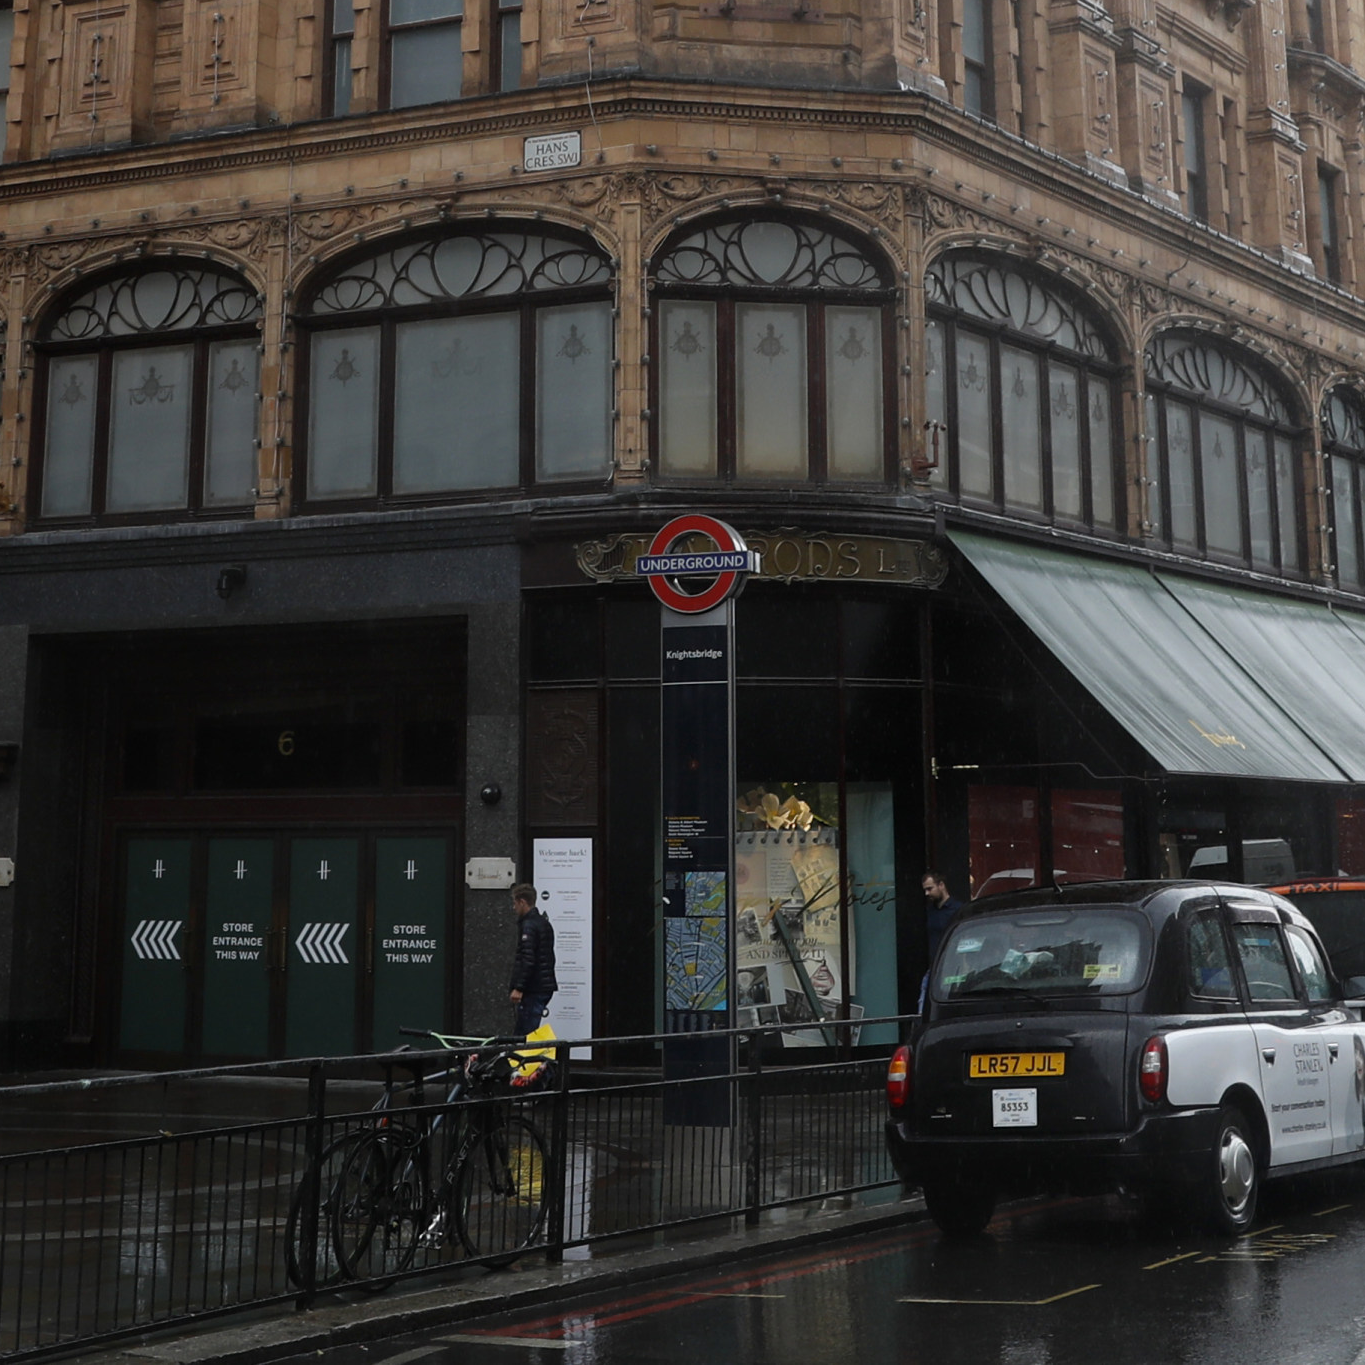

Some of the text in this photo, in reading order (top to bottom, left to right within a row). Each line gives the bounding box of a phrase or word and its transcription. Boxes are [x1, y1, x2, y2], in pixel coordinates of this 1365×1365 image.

[536, 141, 569, 155] HANS
[640, 555, 744, 572] UNDERGROUND
[666, 648, 723, 661] Knightsbridge
[276, 730, 295, 756] 6
[1293, 882, 1338, 894] TAXI
[222, 922, 254, 933] STORE
[392, 924, 427, 935] STORE
[212, 936, 263, 947] ENTRANCE
[382, 938, 437, 950] ENTRANCE
[215, 950, 260, 961] THIS WAY
[385, 952, 434, 964] THIS WAY
[746, 949, 770, 959] AND
[1293, 1042, 1320, 1058] CHARLES
[977, 1055, 1057, 1074] LR57 JJL
[1000, 1102, 1029, 1113] 85353
